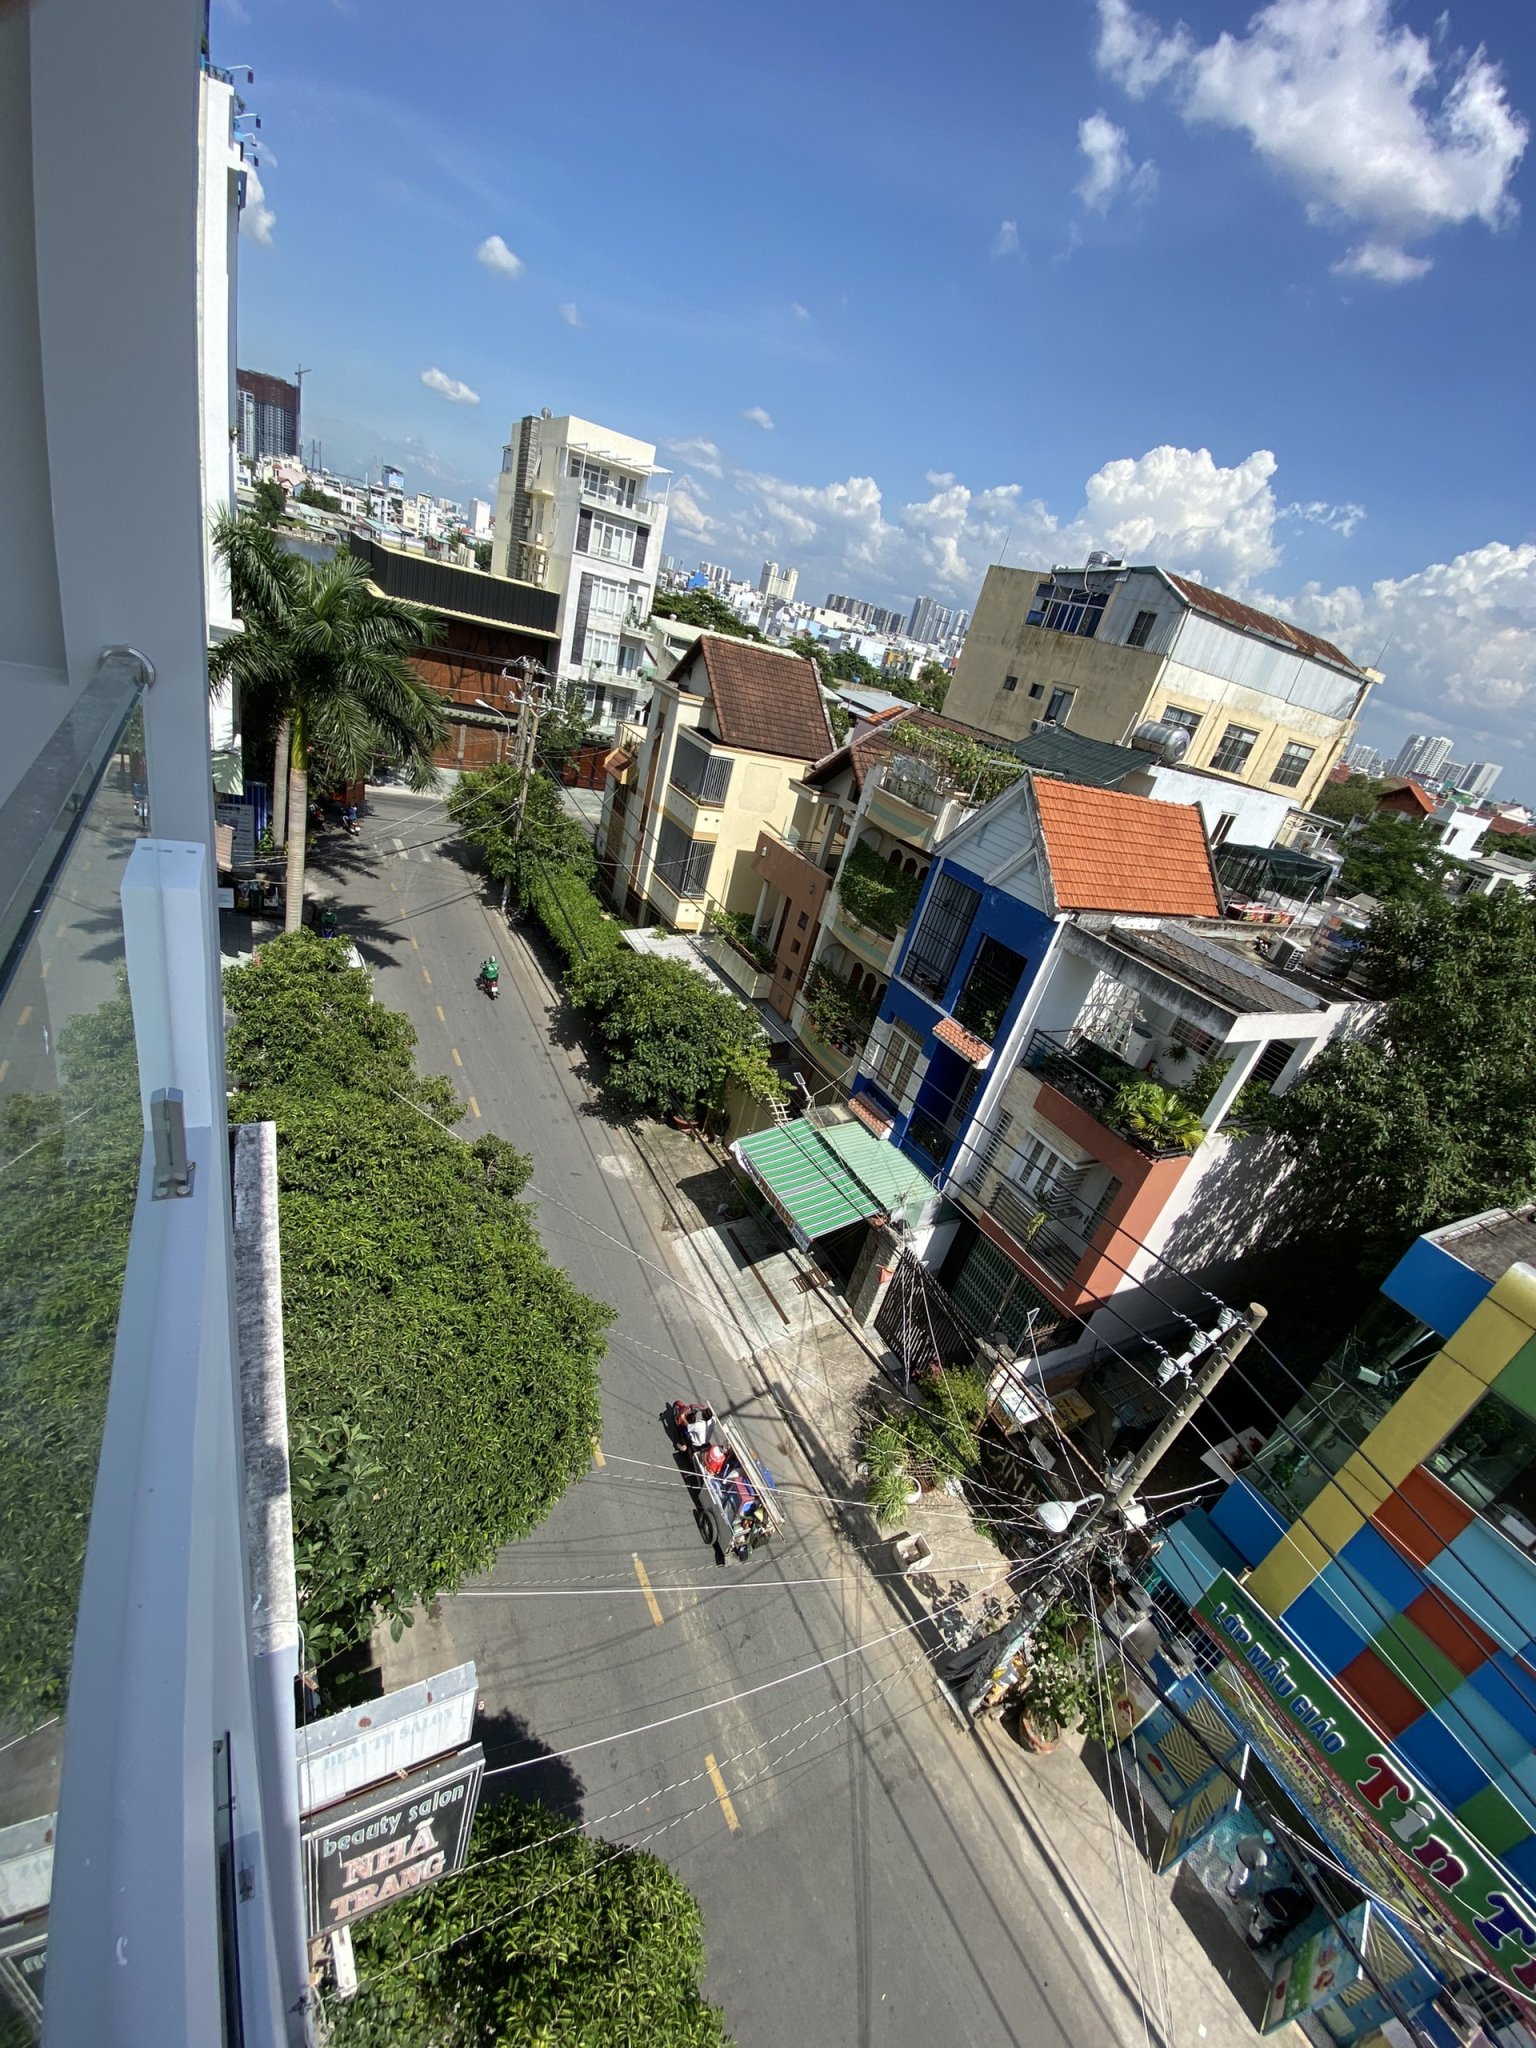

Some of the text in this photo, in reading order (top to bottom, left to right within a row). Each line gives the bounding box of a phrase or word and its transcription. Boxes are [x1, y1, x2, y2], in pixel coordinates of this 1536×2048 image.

[1211, 1602, 1252, 1643] LỚP
[1246, 1642, 1297, 1698] MẪU
[1290, 1694, 1345, 1754] GIÁO
[323, 1784, 465, 1857] beauty salon
[1356, 1754, 1467, 1893] Tin
[329, 1850, 446, 1921] TRANG
